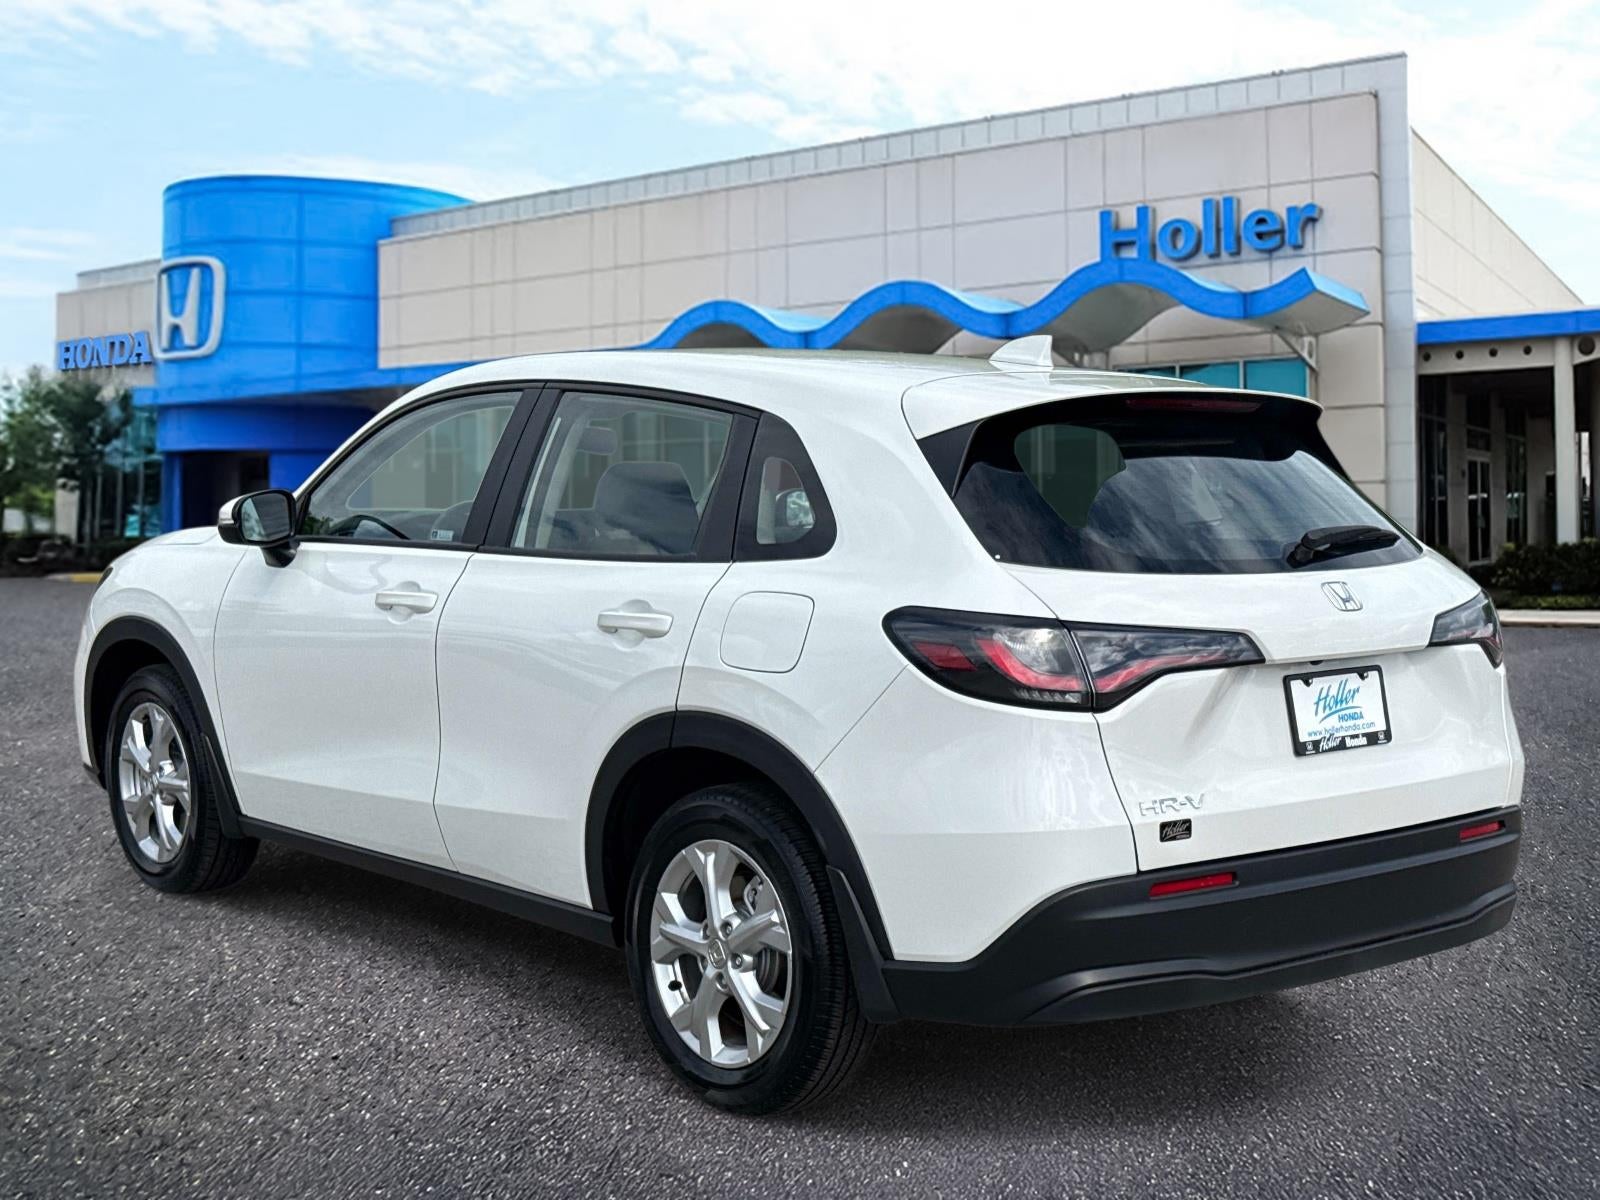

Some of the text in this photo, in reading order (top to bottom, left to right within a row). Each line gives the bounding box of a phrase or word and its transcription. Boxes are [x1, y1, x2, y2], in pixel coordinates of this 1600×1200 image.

[1099, 195, 1322, 261] Holler
[57, 330, 153, 370] HONDA
[1314, 678, 1361, 716] Holler
[1338, 711, 1364, 723] HONDA
[1138, 793, 1204, 816] HR-V
[1162, 820, 1189, 837] Holler
